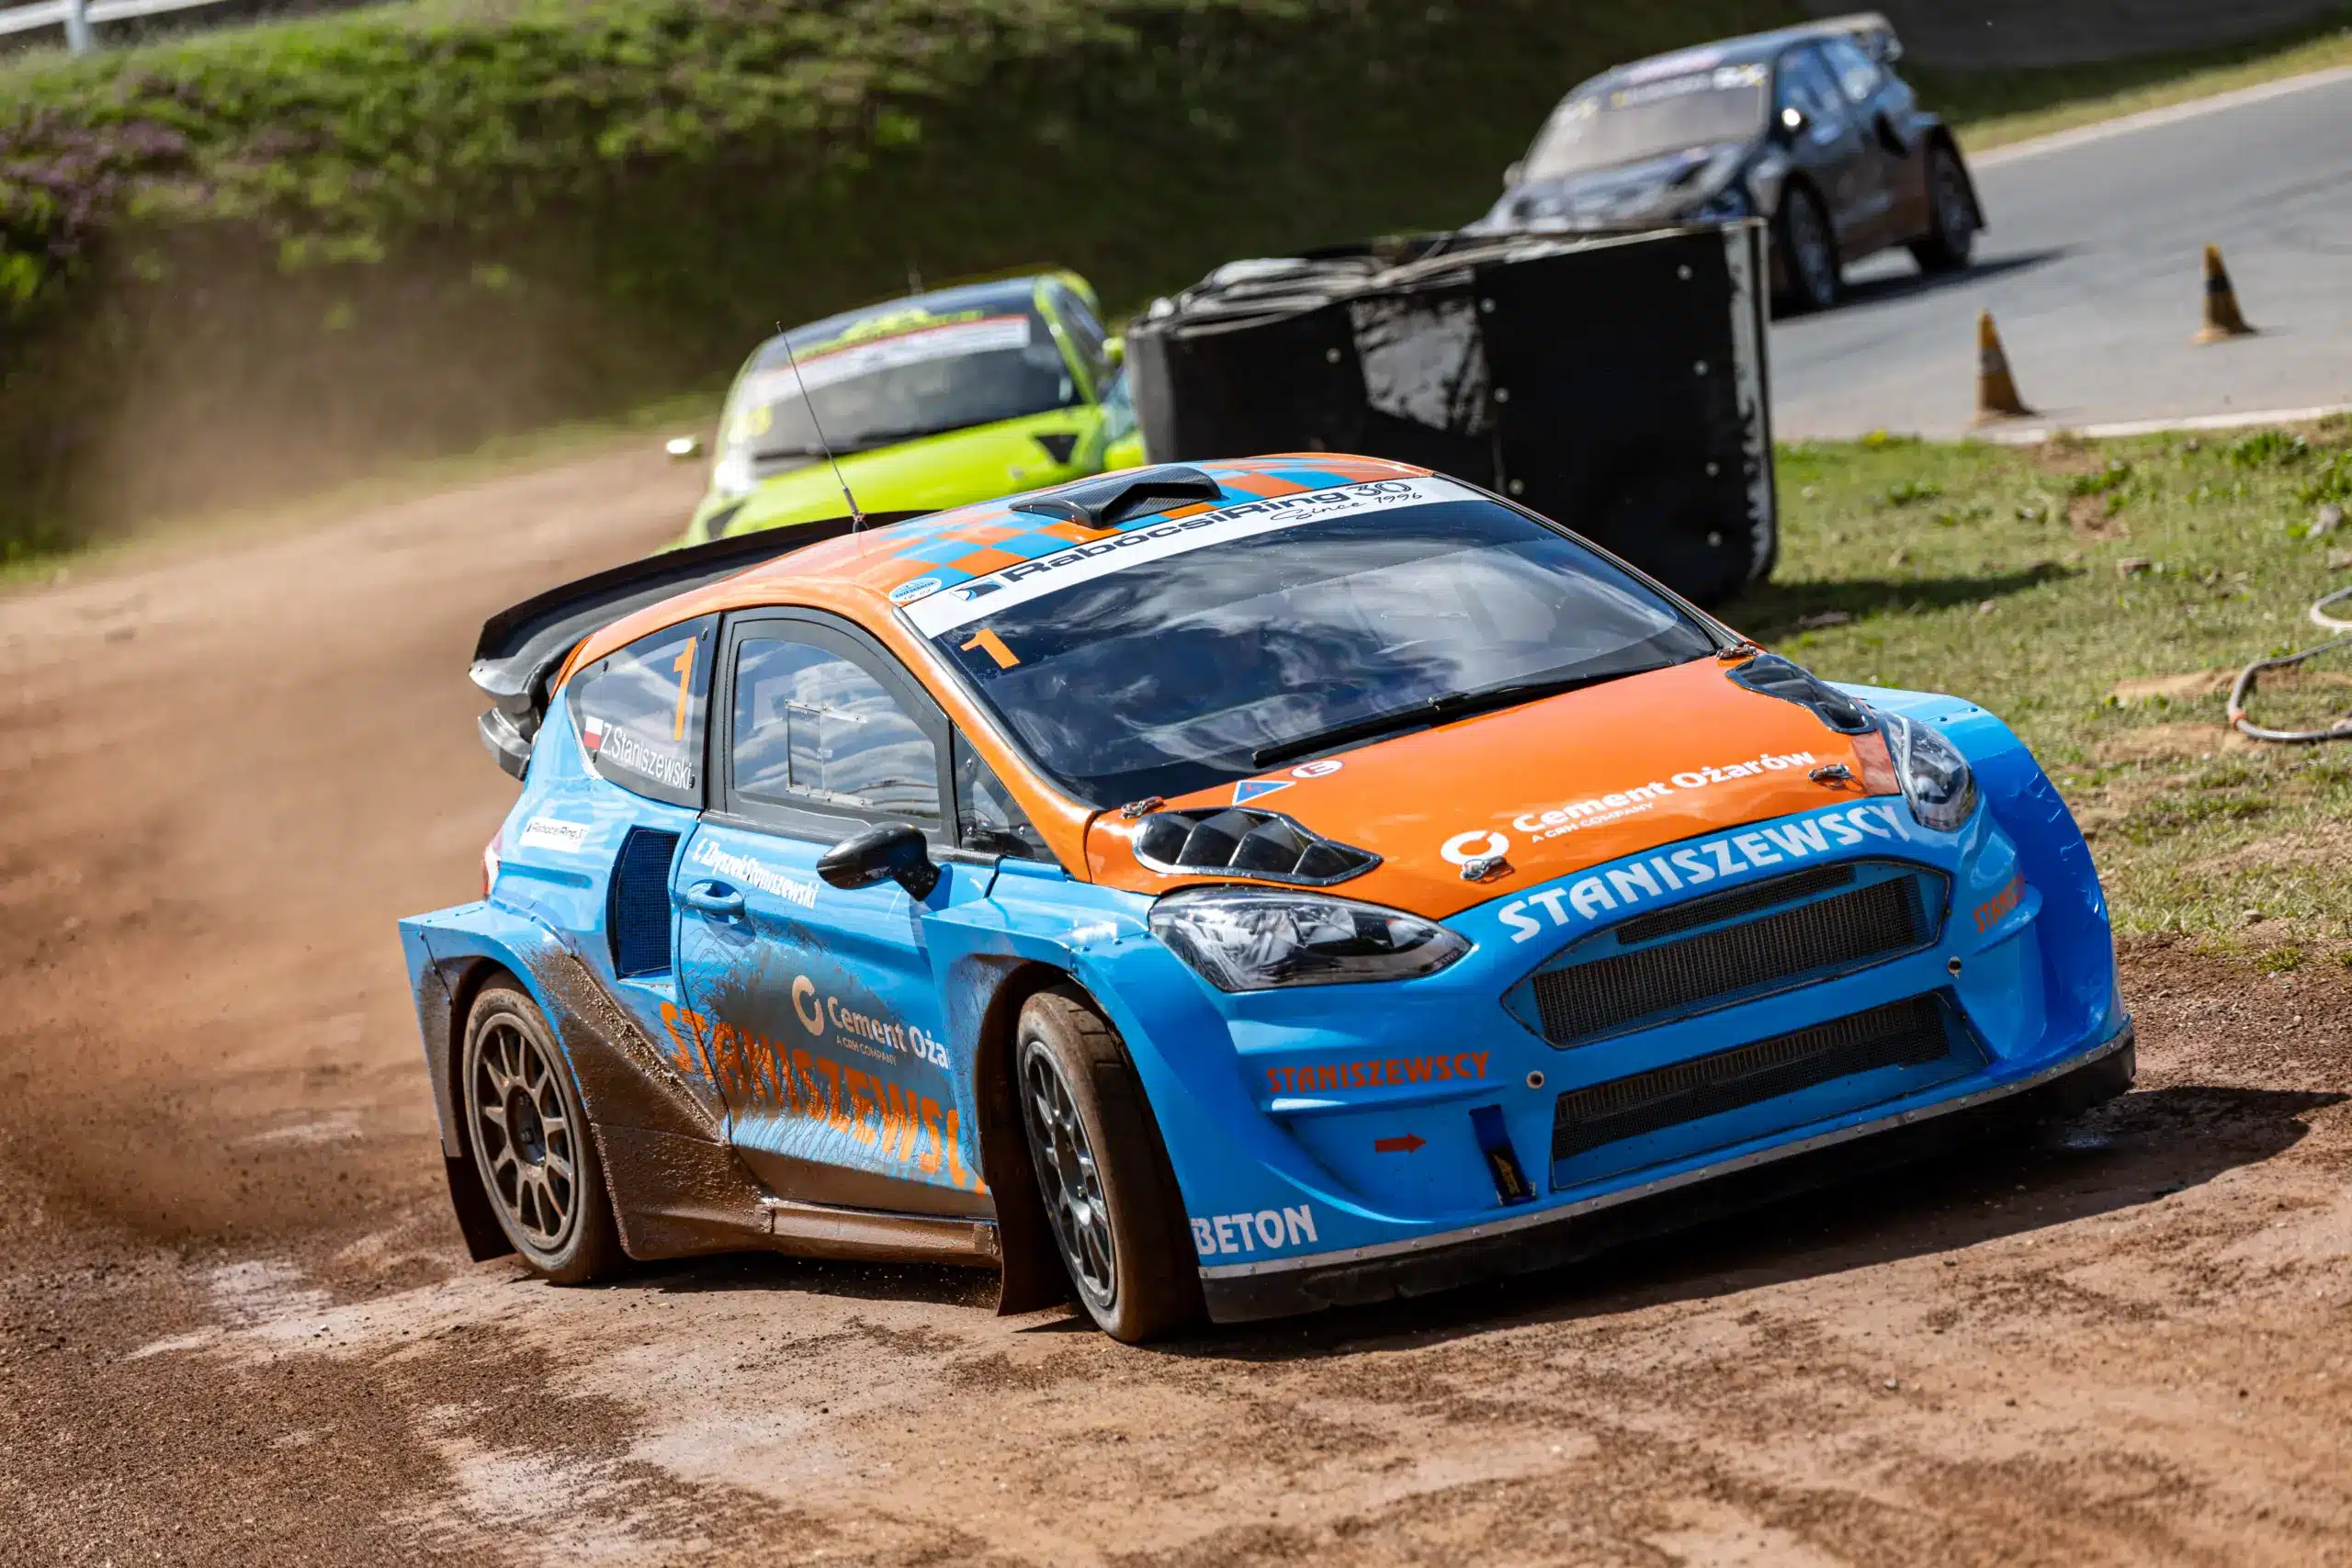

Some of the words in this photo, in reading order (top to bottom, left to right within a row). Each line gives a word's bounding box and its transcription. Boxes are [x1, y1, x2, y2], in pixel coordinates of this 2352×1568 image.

[1000, 491, 1351, 583] RabócsiRing
[1345, 481, 1412, 498] 30
[1270, 502, 1367, 521] Since
[1373, 491, 1423, 504] 1996
[959, 627, 1021, 670] 1
[673, 636, 697, 742] 1
[1513, 781, 1674, 833] Cement
[1671, 750, 1817, 790] Ożarów
[1579, 802, 1654, 827] COMPANY
[1498, 804, 1912, 944] STANISZEWSCY
[827, 996, 908, 1053] Cement
[909, 1025, 950, 1070] Oża
[859, 1043, 897, 1066] COMPANY
[1266, 1051, 1490, 1094] STANISZEWSCY
[1191, 1204, 1318, 1257] BETON
